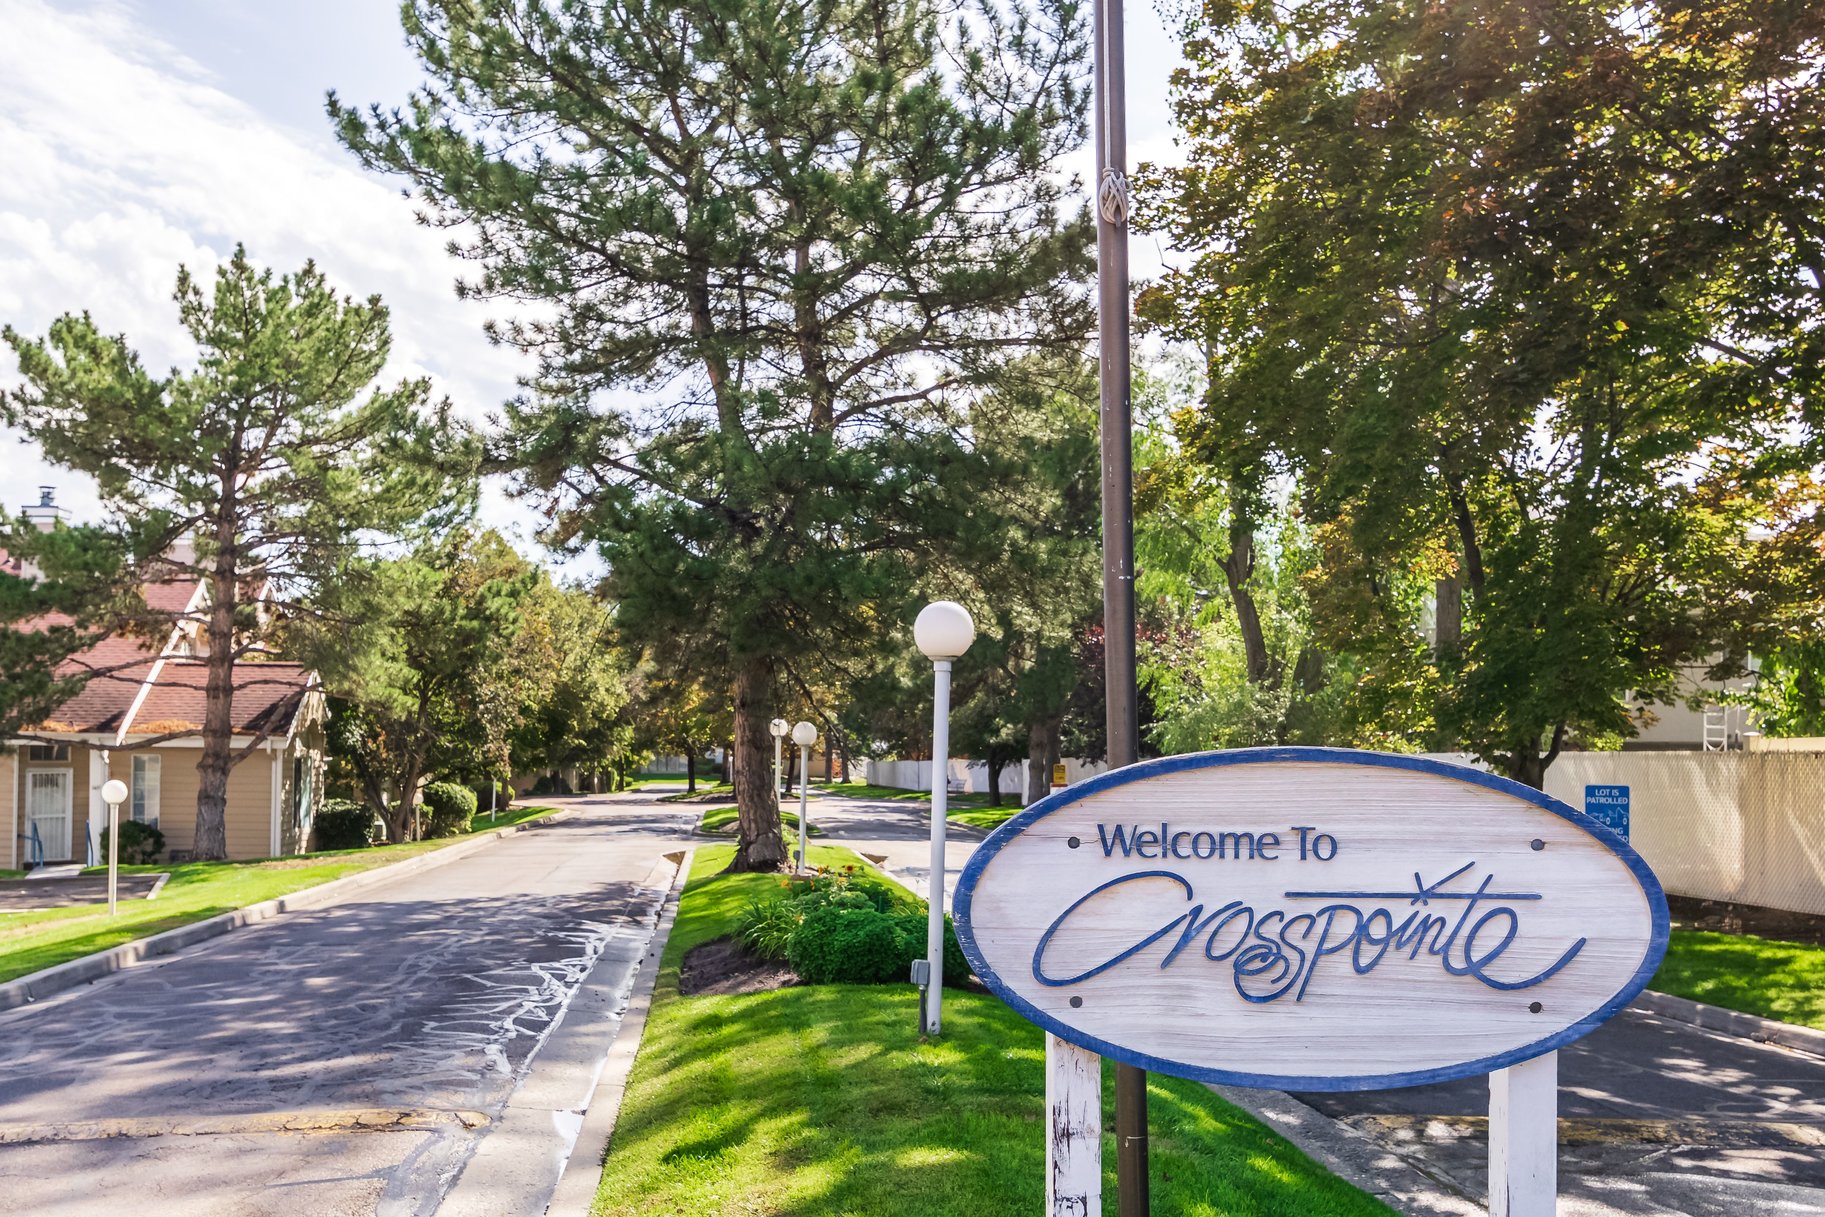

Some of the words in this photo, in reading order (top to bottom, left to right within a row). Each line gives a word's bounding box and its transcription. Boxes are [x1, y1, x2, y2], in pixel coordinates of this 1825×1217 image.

[1595, 788, 1610, 796] LOT
[1611, 788, 1619, 796] IS
[1586, 796, 1628, 804] PATROLLED
[1097, 822, 1280, 860] Welcome
[1291, 826, 1338, 861] To
